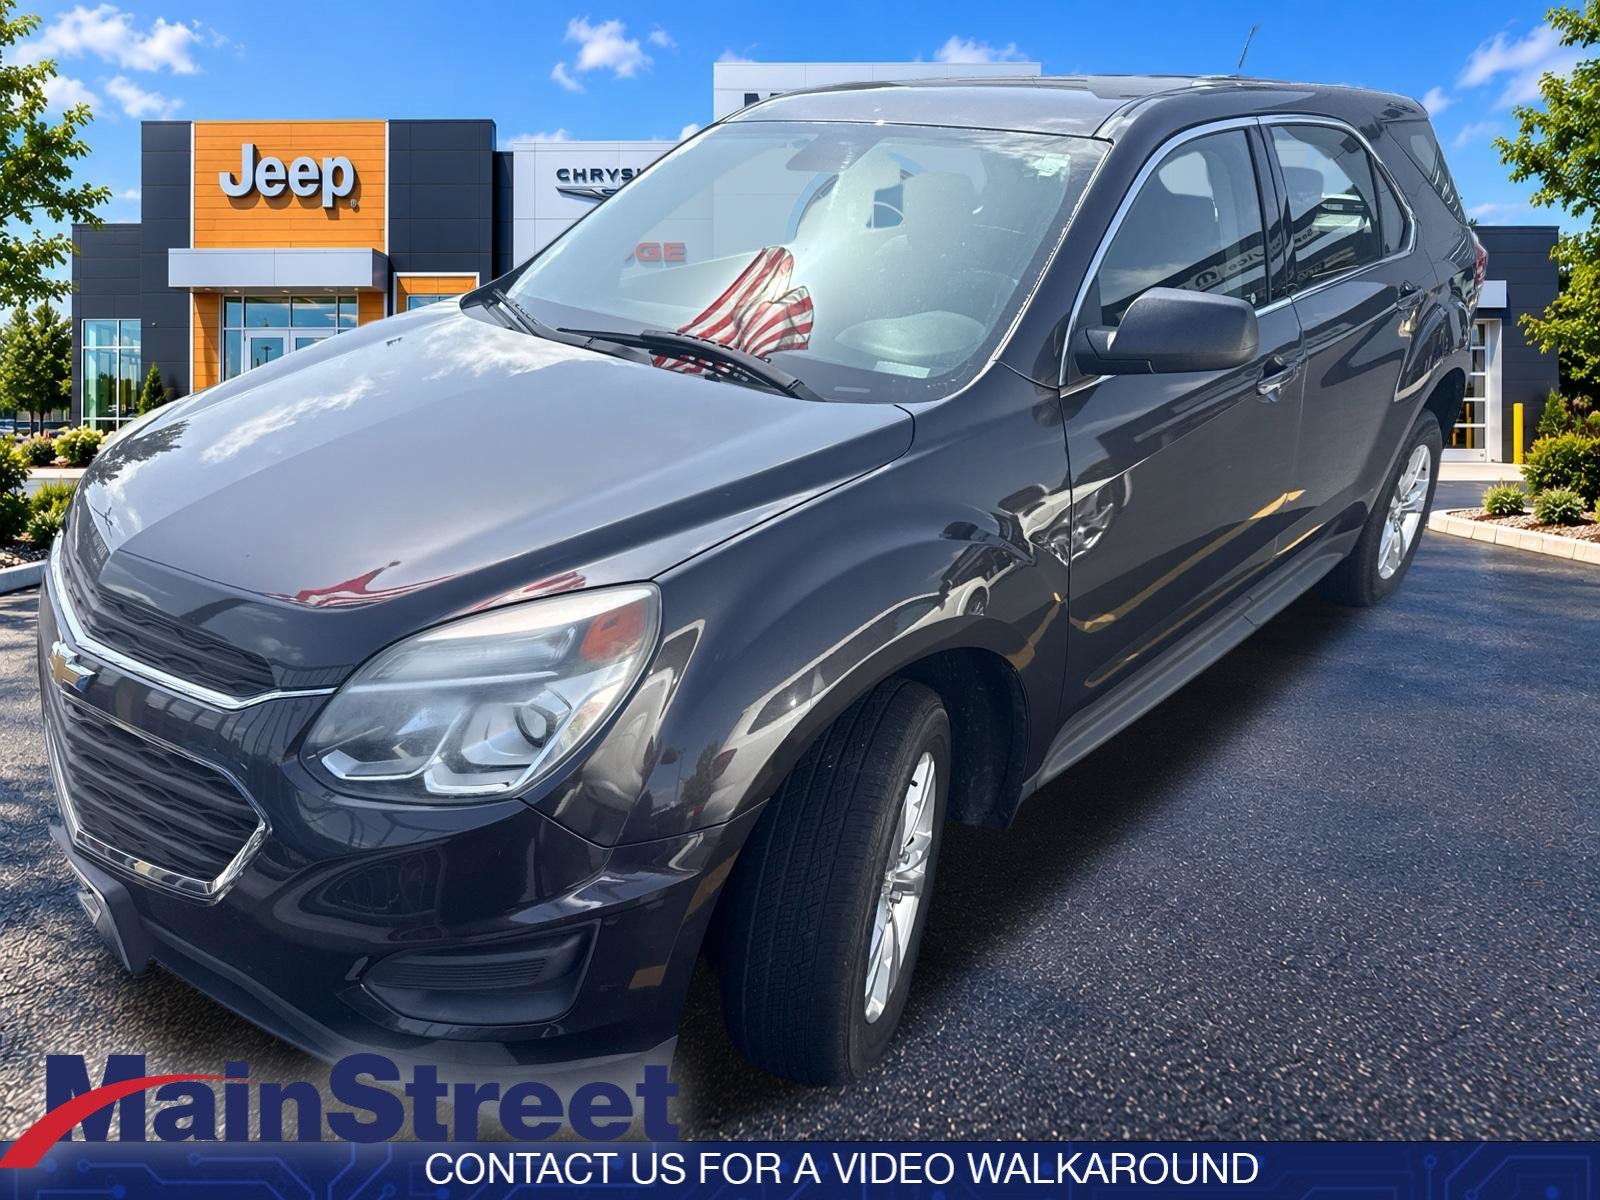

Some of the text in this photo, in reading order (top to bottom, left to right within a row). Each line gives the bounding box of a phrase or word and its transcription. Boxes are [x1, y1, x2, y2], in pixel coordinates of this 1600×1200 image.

[219, 143, 355, 208] Jeep
[556, 168, 642, 183] CHRYS
[624, 242, 686, 262] GE
